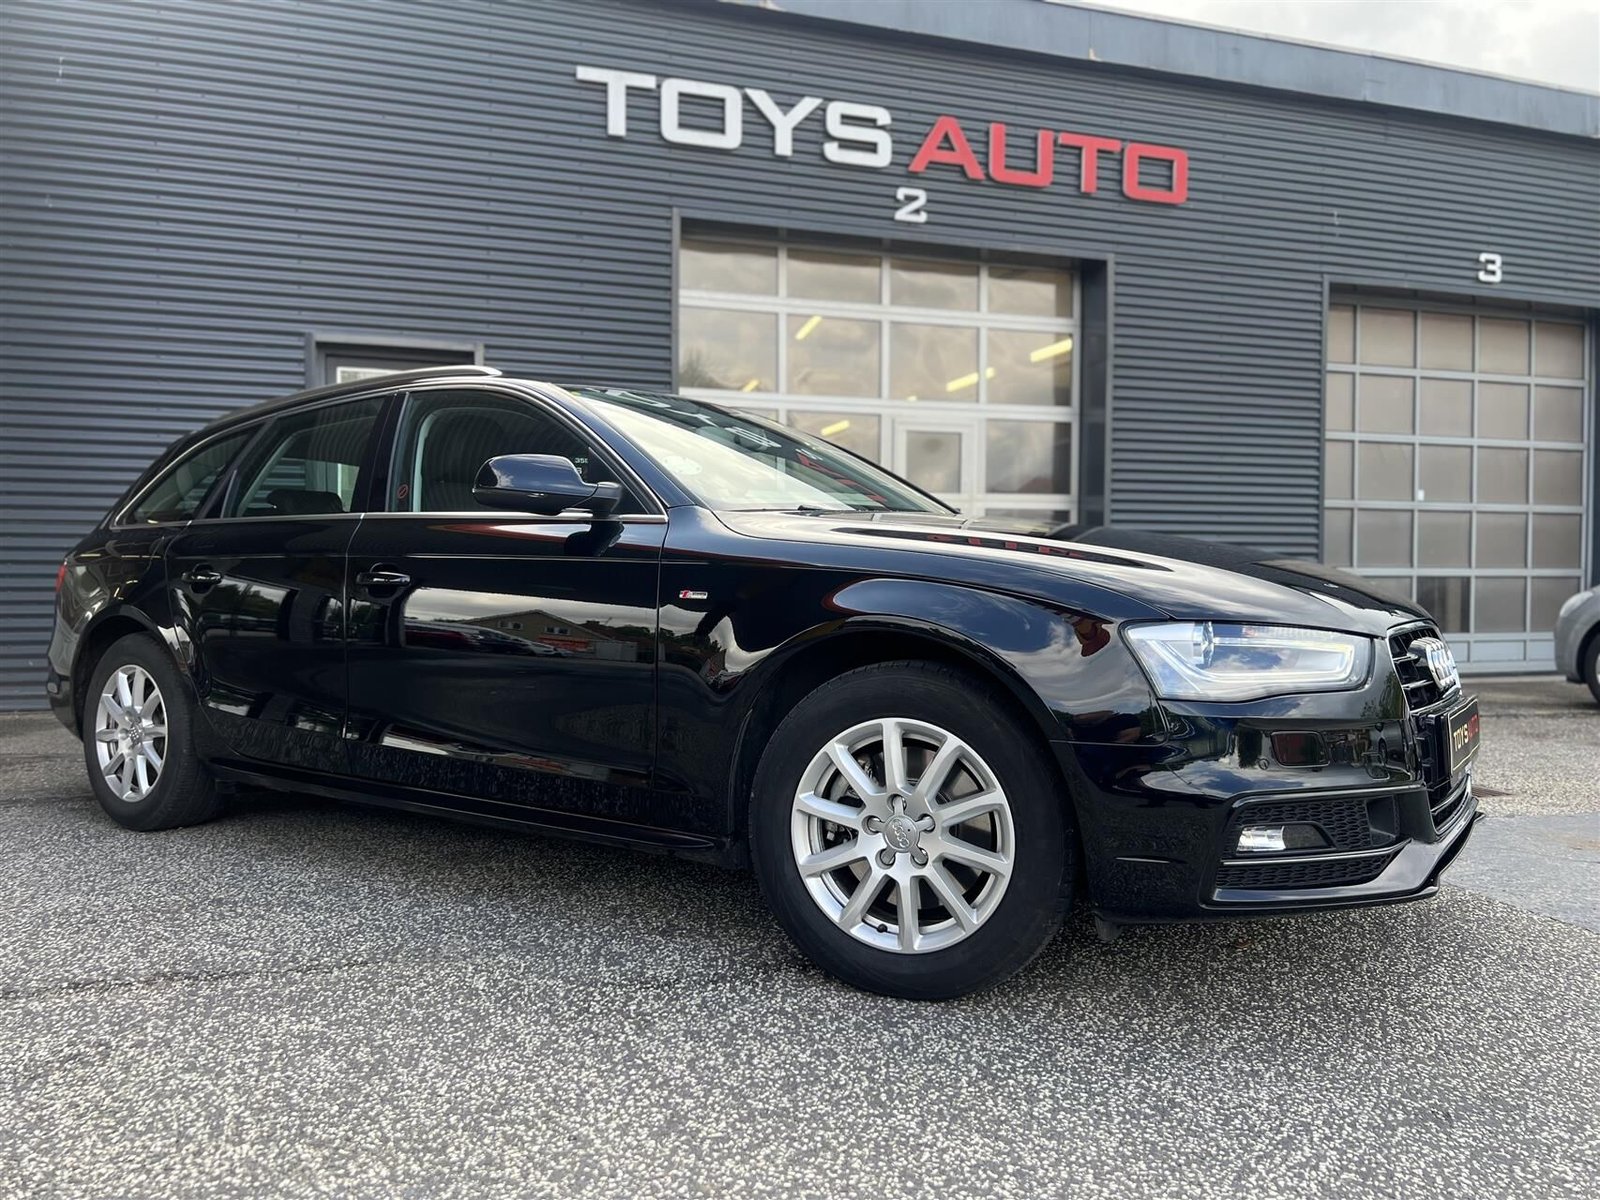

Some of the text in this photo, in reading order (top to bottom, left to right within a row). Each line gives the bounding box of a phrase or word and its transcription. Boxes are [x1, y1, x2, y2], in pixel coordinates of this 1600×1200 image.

[575, 65, 1190, 205] TOYS AUTO
[894, 186, 929, 224] 2
[1478, 252, 1503, 283] 3
[1453, 723, 1469, 752] TOYS
